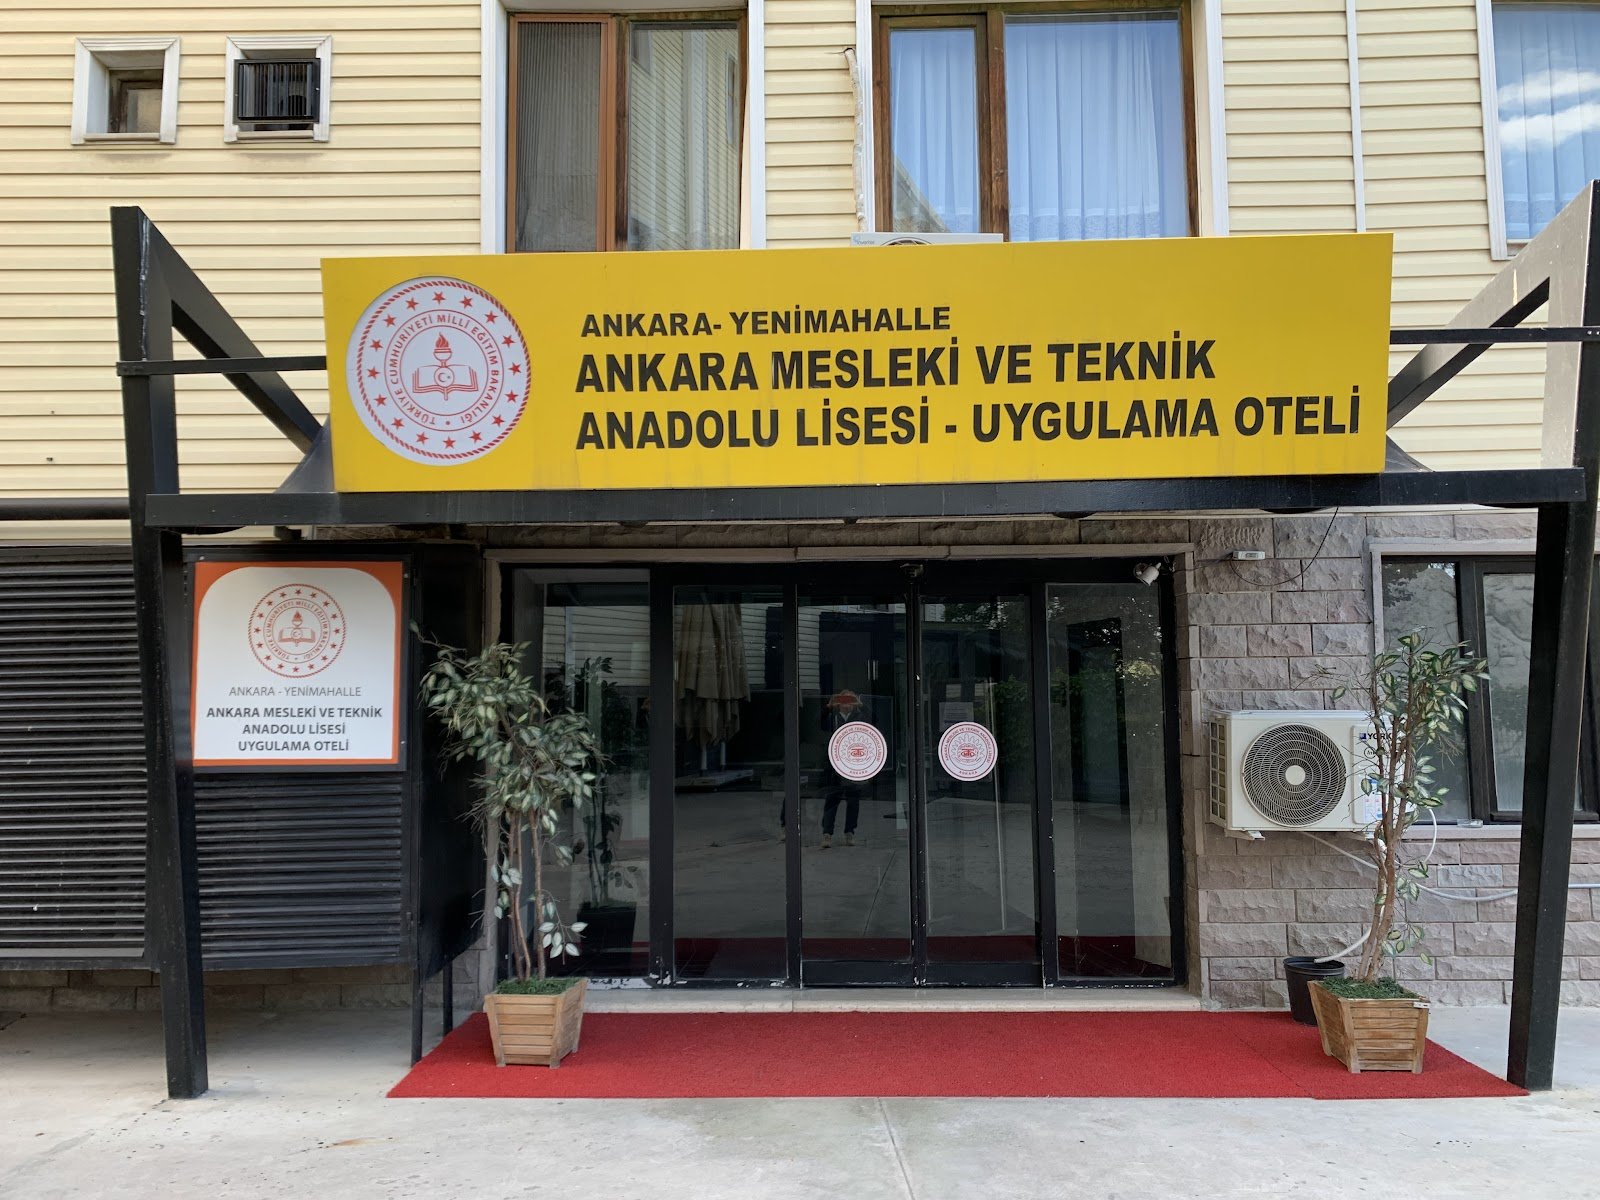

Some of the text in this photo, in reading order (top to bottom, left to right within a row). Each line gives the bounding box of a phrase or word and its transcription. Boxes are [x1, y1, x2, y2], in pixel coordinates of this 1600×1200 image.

[580, 304, 951, 337] ANKARA- YENİMAHALLE
[389, 313, 499, 425] TÜRKİYE CUMHURİYETİ MİLLİ EĞİTİM BAKANLIĞI
[575, 330, 1216, 393] ANKARA MESLEKİ VE TEKNİK
[575, 385, 1361, 450] ANADOLU LİSESİ - UYGULAMA OTELİ
[228, 686, 276, 697] ANKARA
[285, 685, 362, 697] YENİMAHALLE
[206, 705, 382, 718] ANKARA MESLEKİ VE TEKNİK
[242, 723, 345, 735] ANADOLU LİSESİ
[238, 739, 349, 751] UYGULAMA OTELİ
